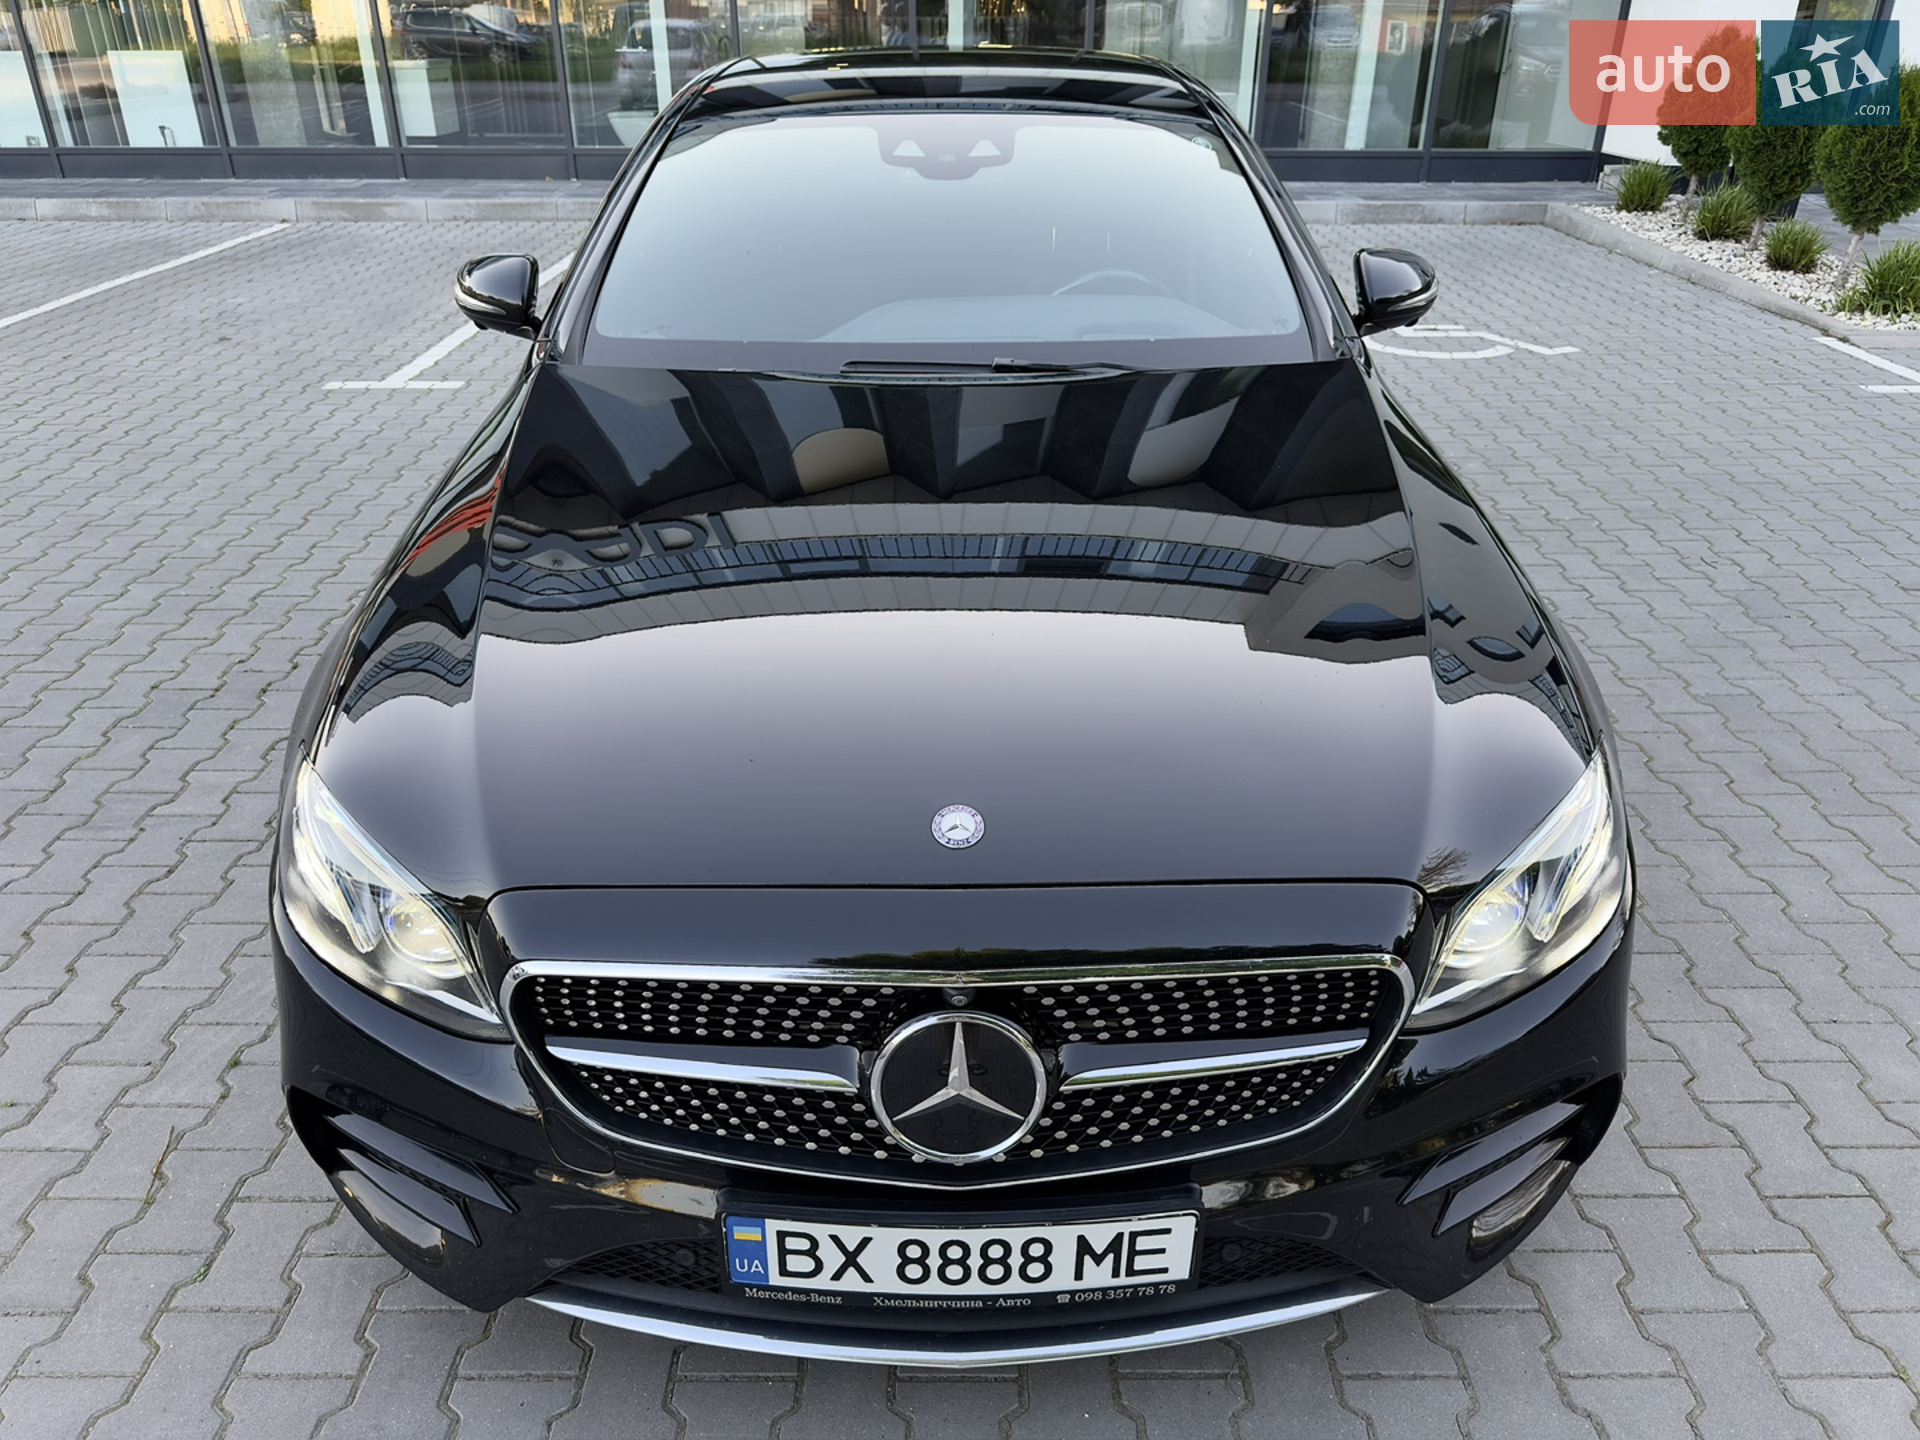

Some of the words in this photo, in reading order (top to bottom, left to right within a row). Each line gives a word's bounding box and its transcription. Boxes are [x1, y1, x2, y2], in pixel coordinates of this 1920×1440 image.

[775, 1229, 875, 1284] BX
[896, 1236, 1054, 1286] 8888
[1073, 1227, 1173, 1282] ME
[735, 1258, 765, 1275] UA
[744, 1287, 843, 1304] Mercedes-Benz
[1074, 1291, 1103, 1302] 098
[1105, 1288, 1134, 1300] 357
[1137, 1286, 1155, 1297] 78
[1158, 1283, 1176, 1294] 78
